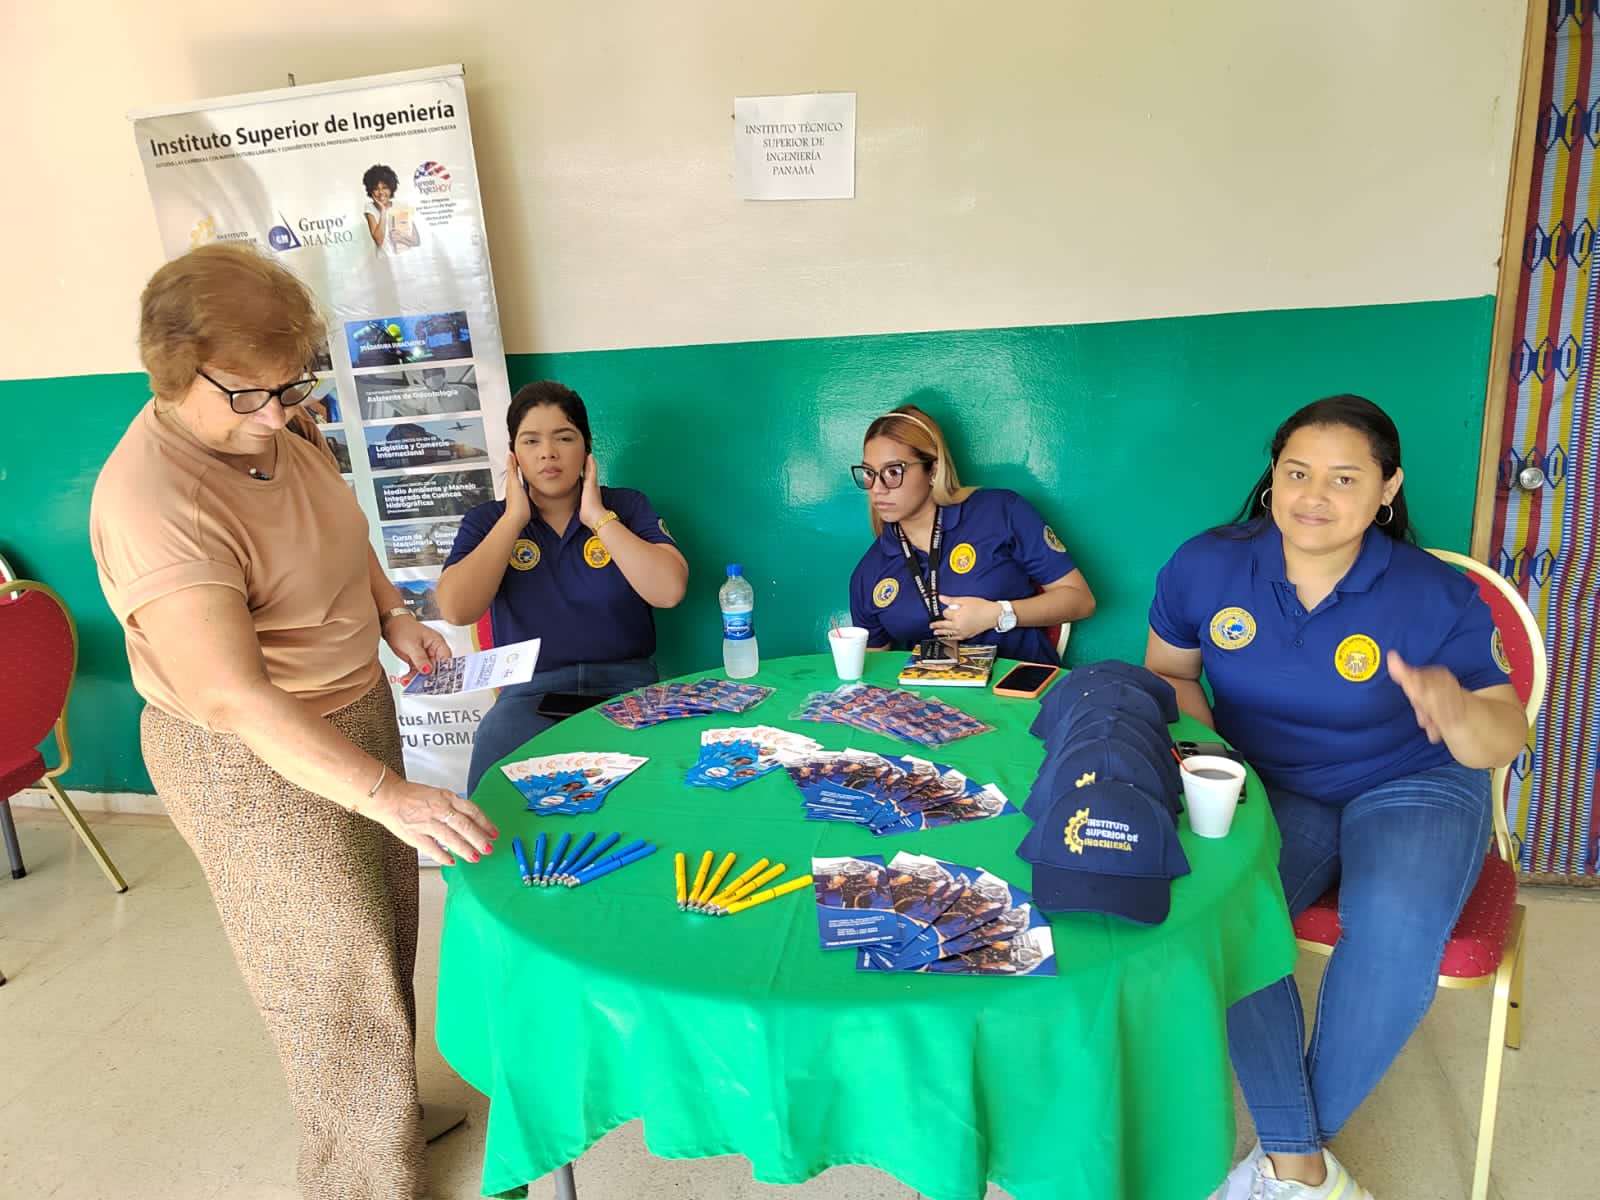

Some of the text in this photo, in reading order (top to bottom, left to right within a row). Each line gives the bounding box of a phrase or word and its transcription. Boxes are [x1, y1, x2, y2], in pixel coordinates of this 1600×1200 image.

[150, 99, 454, 156] Instituto Superior de Ingeniería
[745, 120, 843, 135] INSTITUTO TÉCNICO
[762, 136, 825, 148] SUPERIOR DE
[766, 150, 822, 162] INGENIERÍA
[771, 162, 815, 176] PANAMÁ
[298, 216, 344, 233] Grupo
[302, 230, 353, 248] MAKRO
[375, 441, 409, 454] Logística
[410, 442, 415, 451] y
[415, 440, 450, 449] Comercio
[376, 449, 425, 459] Internacional
[383, 487, 407, 496] Medio
[407, 486, 442, 495] Ambiente
[448, 482, 477, 491] Manejo
[384, 491, 463, 504] Integrado de Cuencas
[427, 708, 482, 724] METAS
[1087, 818, 1130, 832] INSTITUTO
[1085, 828, 1139, 843] SUPERIOR DE
[1083, 837, 1133, 852] INGENIERÍA
